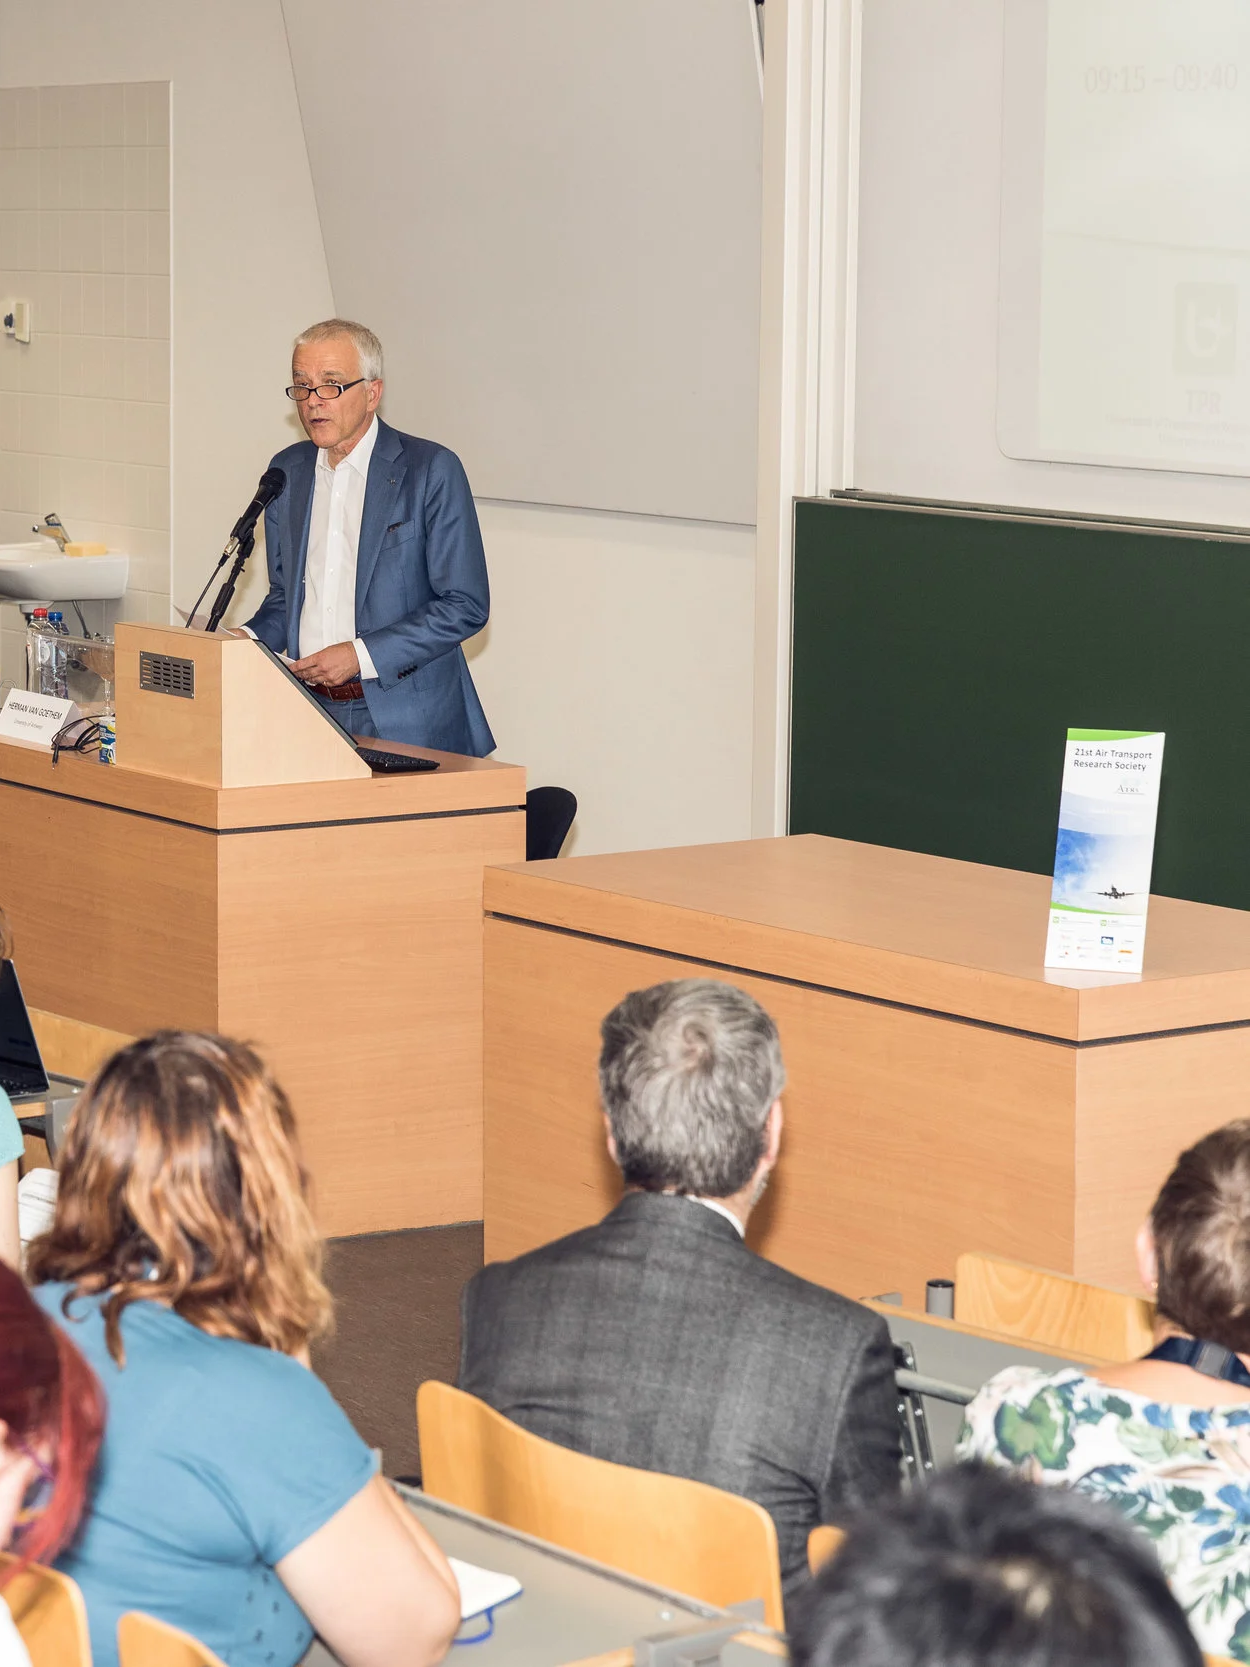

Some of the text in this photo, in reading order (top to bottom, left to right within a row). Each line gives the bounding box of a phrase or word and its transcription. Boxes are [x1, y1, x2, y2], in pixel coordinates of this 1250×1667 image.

[1084, 64, 1146, 94] 09:15
[1173, 63, 1239, 92] 09:40
[8, 701, 63, 720] HERMAN VAN GOETHEM
[1074, 748, 1153, 760] 21st Air Transport
[1073, 759, 1147, 772] Research Society
